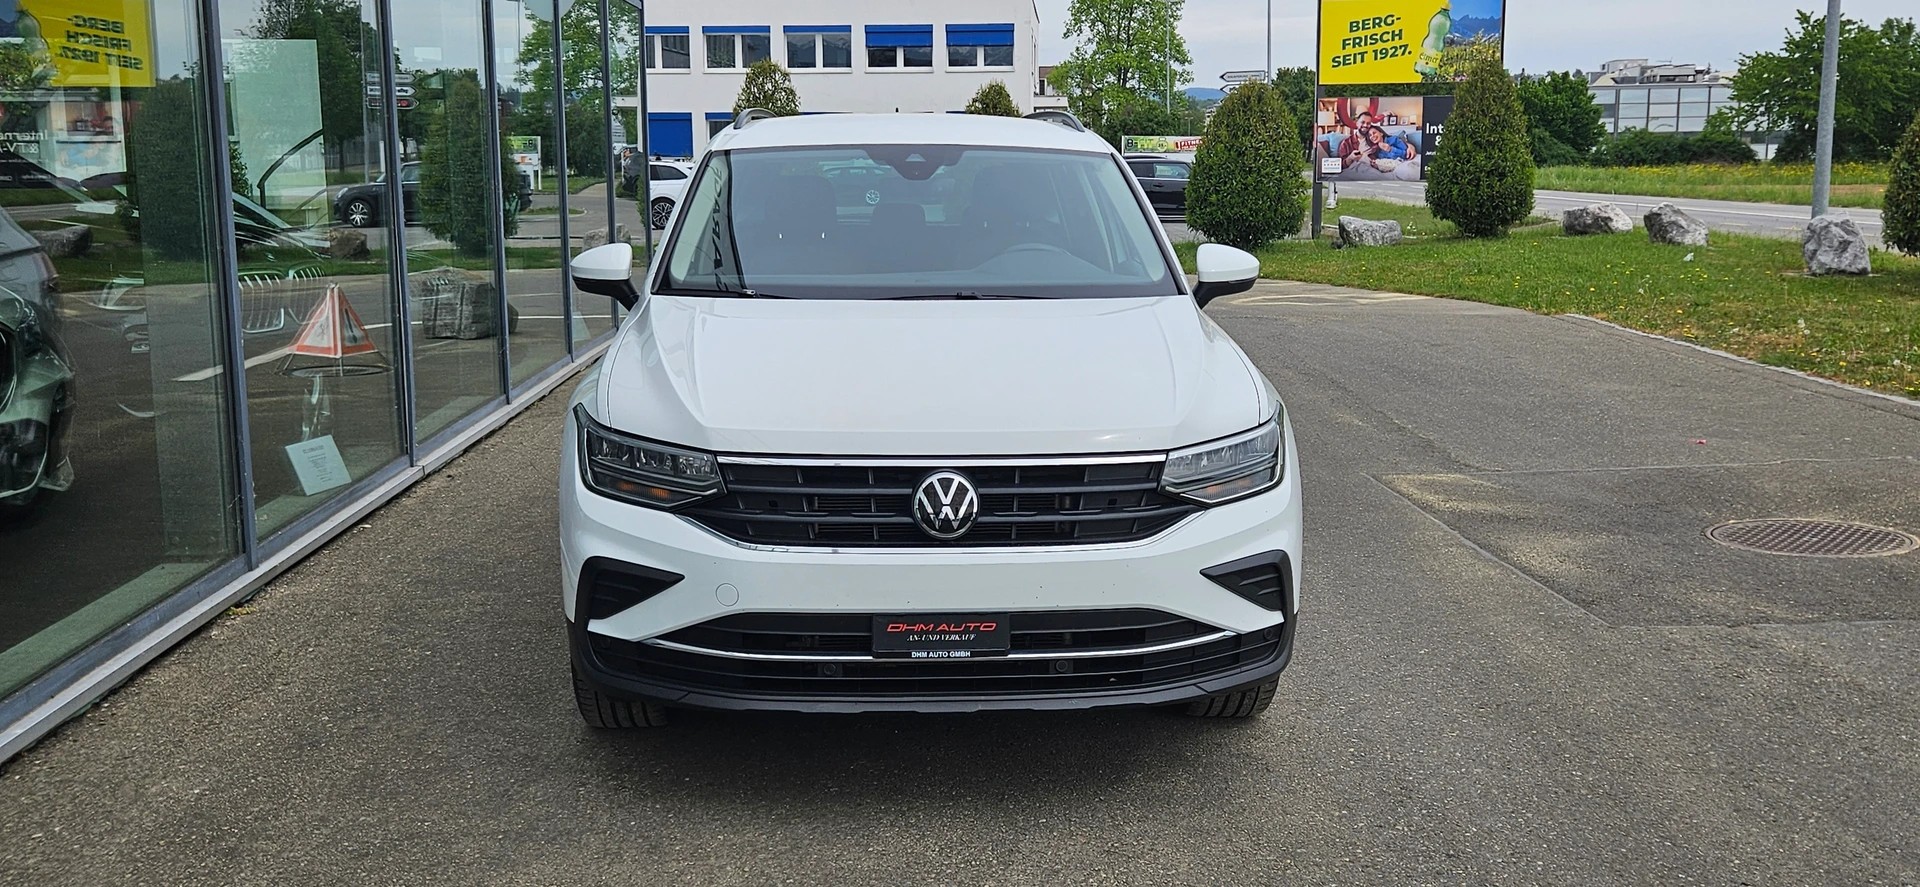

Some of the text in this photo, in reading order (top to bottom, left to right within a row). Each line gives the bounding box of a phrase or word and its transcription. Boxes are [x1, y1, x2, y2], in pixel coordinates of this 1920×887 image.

[1348, 14, 1402, 33] BERG-
[1341, 29, 1404, 50] FRISCH
[1331, 44, 1413, 69] SEIT 1927.
[1425, 122, 1446, 134] Int
[886, 622, 997, 632] DHM AUTO
